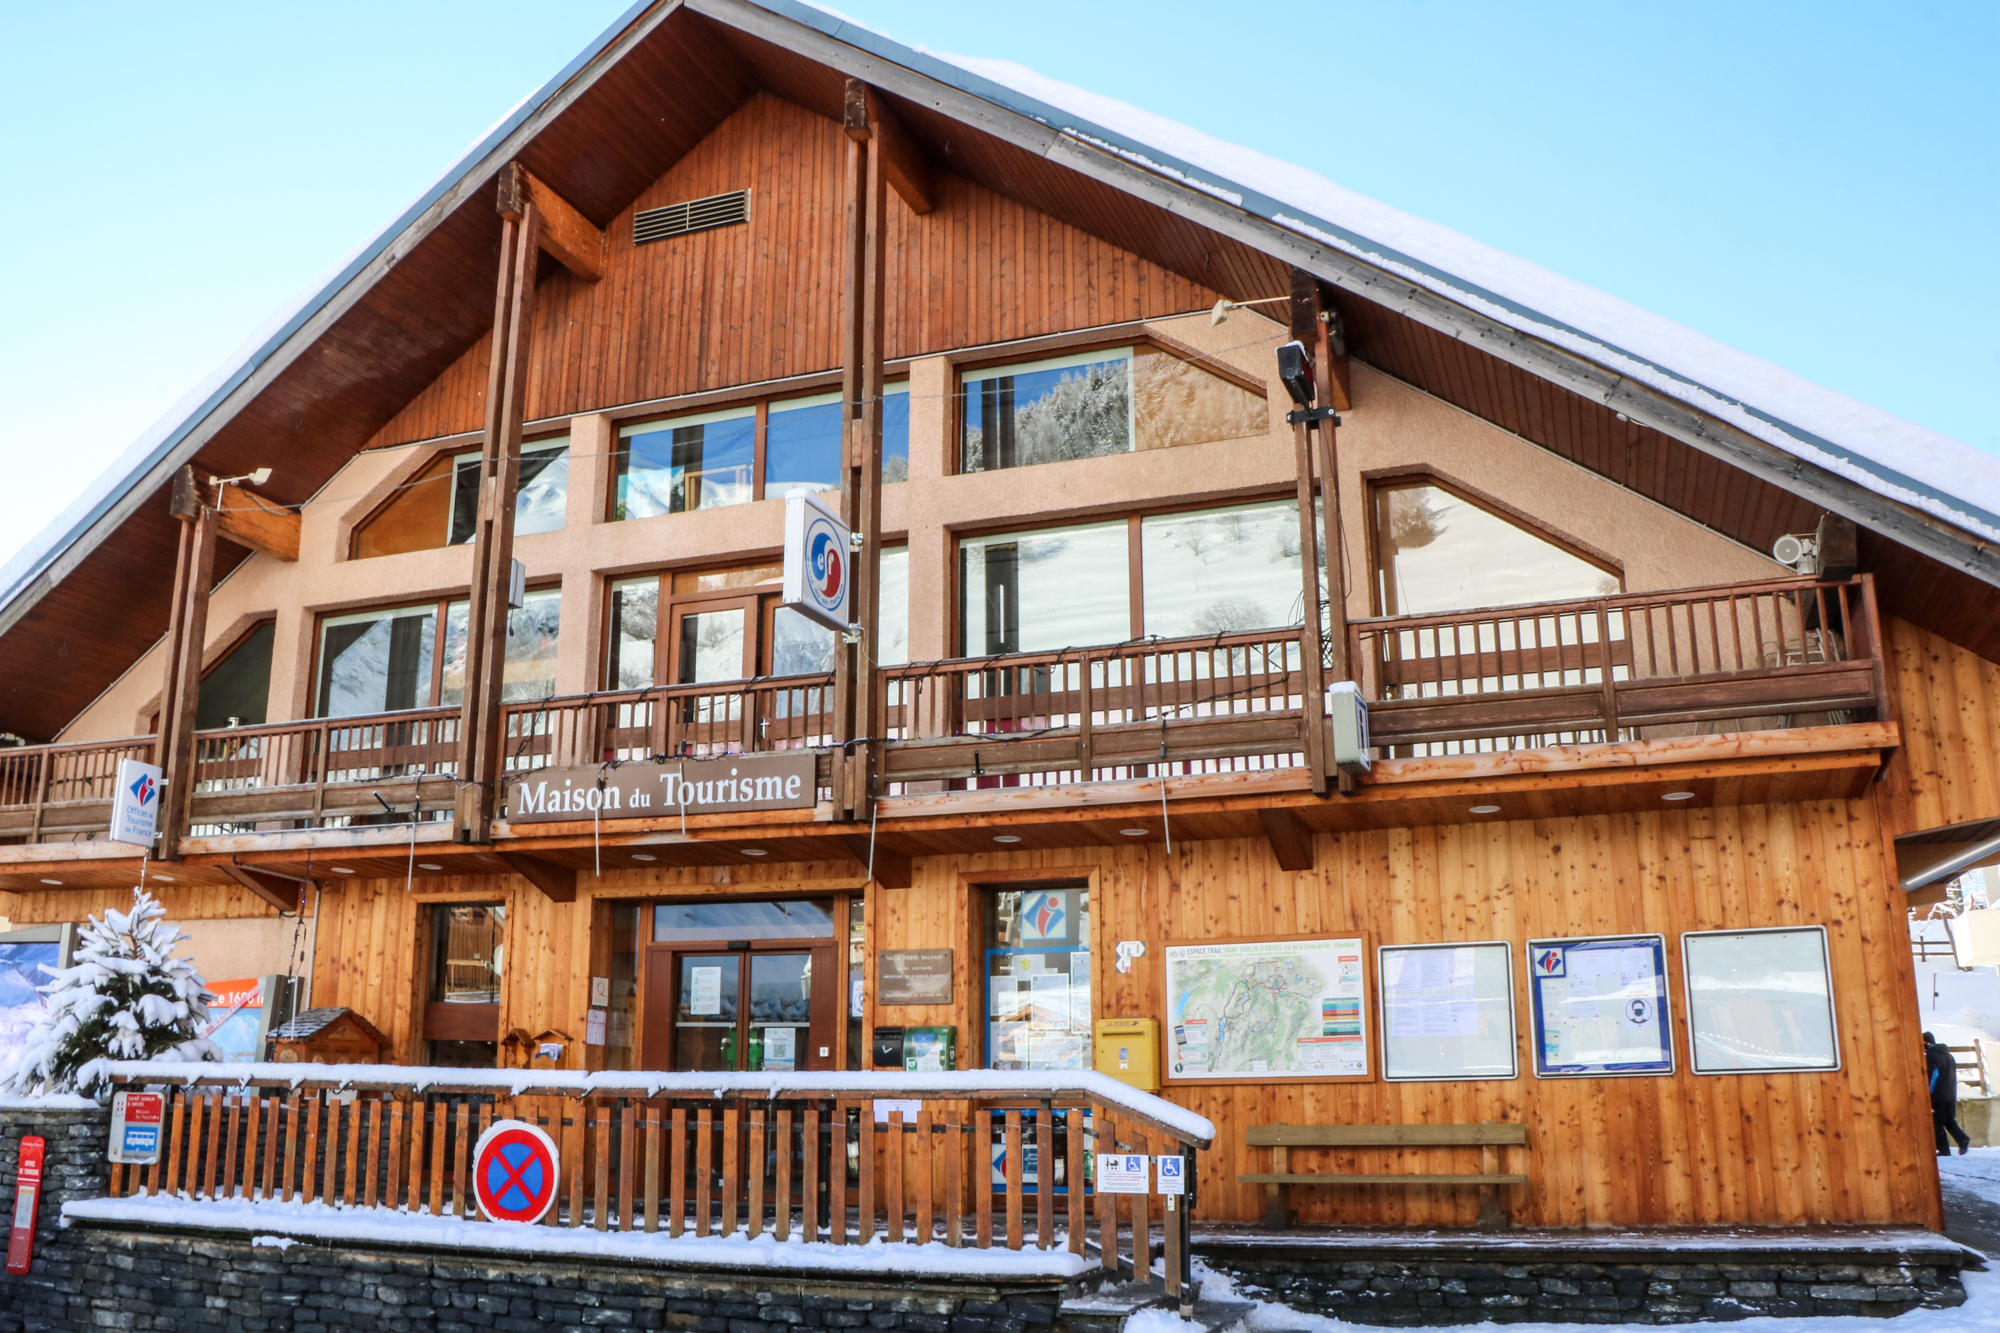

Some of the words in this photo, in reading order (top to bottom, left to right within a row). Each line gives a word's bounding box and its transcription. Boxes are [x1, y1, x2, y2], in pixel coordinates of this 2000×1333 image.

[517, 778, 621, 815] Maison
[629, 788, 651, 809] du
[659, 767, 802, 807] Tourisme
[126, 805, 148, 817] Offices
[126, 814, 153, 828] Tourisme
[132, 826, 152, 837] France
[1240, 945, 1259, 953] SORLIN
